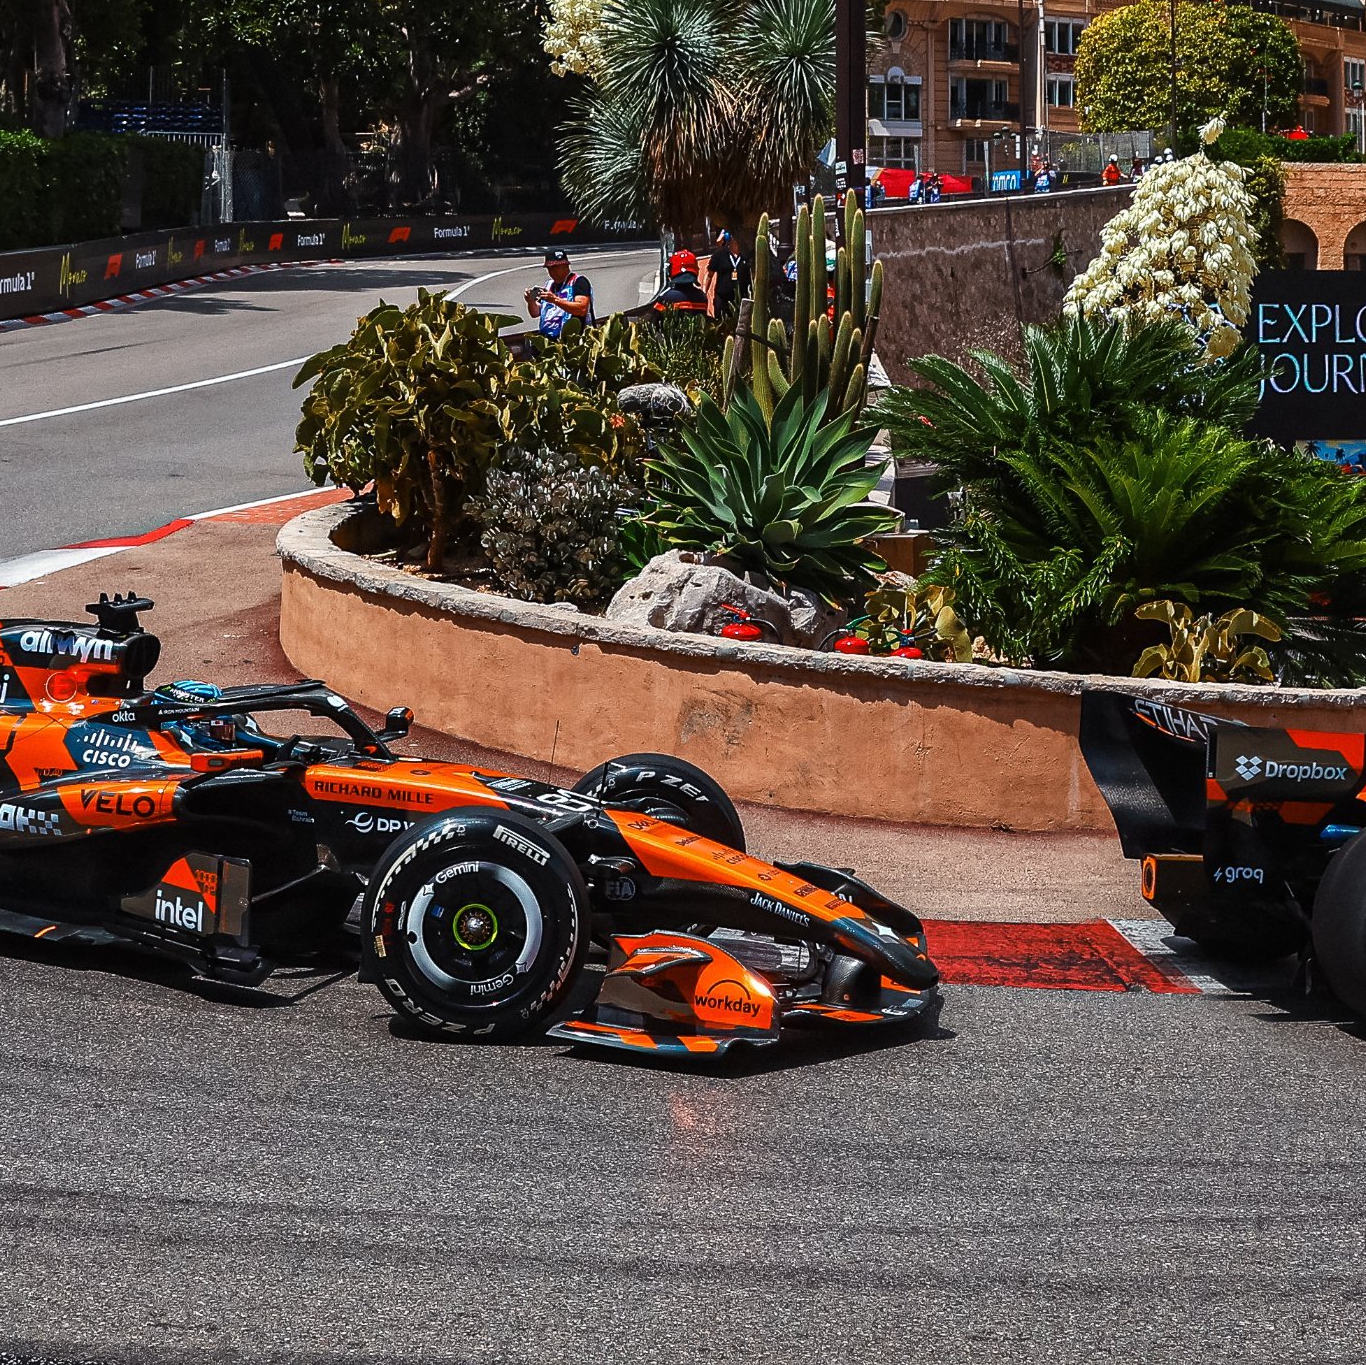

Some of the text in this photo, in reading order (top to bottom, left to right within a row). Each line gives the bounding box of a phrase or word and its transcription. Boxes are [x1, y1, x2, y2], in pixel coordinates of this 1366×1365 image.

[19, 629, 116, 664] allwyn
[112, 710, 136, 724] okta
[82, 749, 132, 769] cisco
[1265, 761, 1348, 783] Dropbox
[80, 787, 156, 819] VELO
[314, 779, 435, 805] RICHARD MILLE
[376, 818, 403, 834] DP
[492, 824, 552, 867] PIRELLI
[434, 860, 480, 885] Gemini
[1225, 866, 1264, 884] groq
[155, 889, 204, 933] intel
[749, 891, 776, 914] JACK
[774, 904, 811, 929] DANIEL'S
[470, 973, 514, 996] Gemini
[385, 978, 467, 1035] ZERO
[694, 993, 762, 1018] workday
